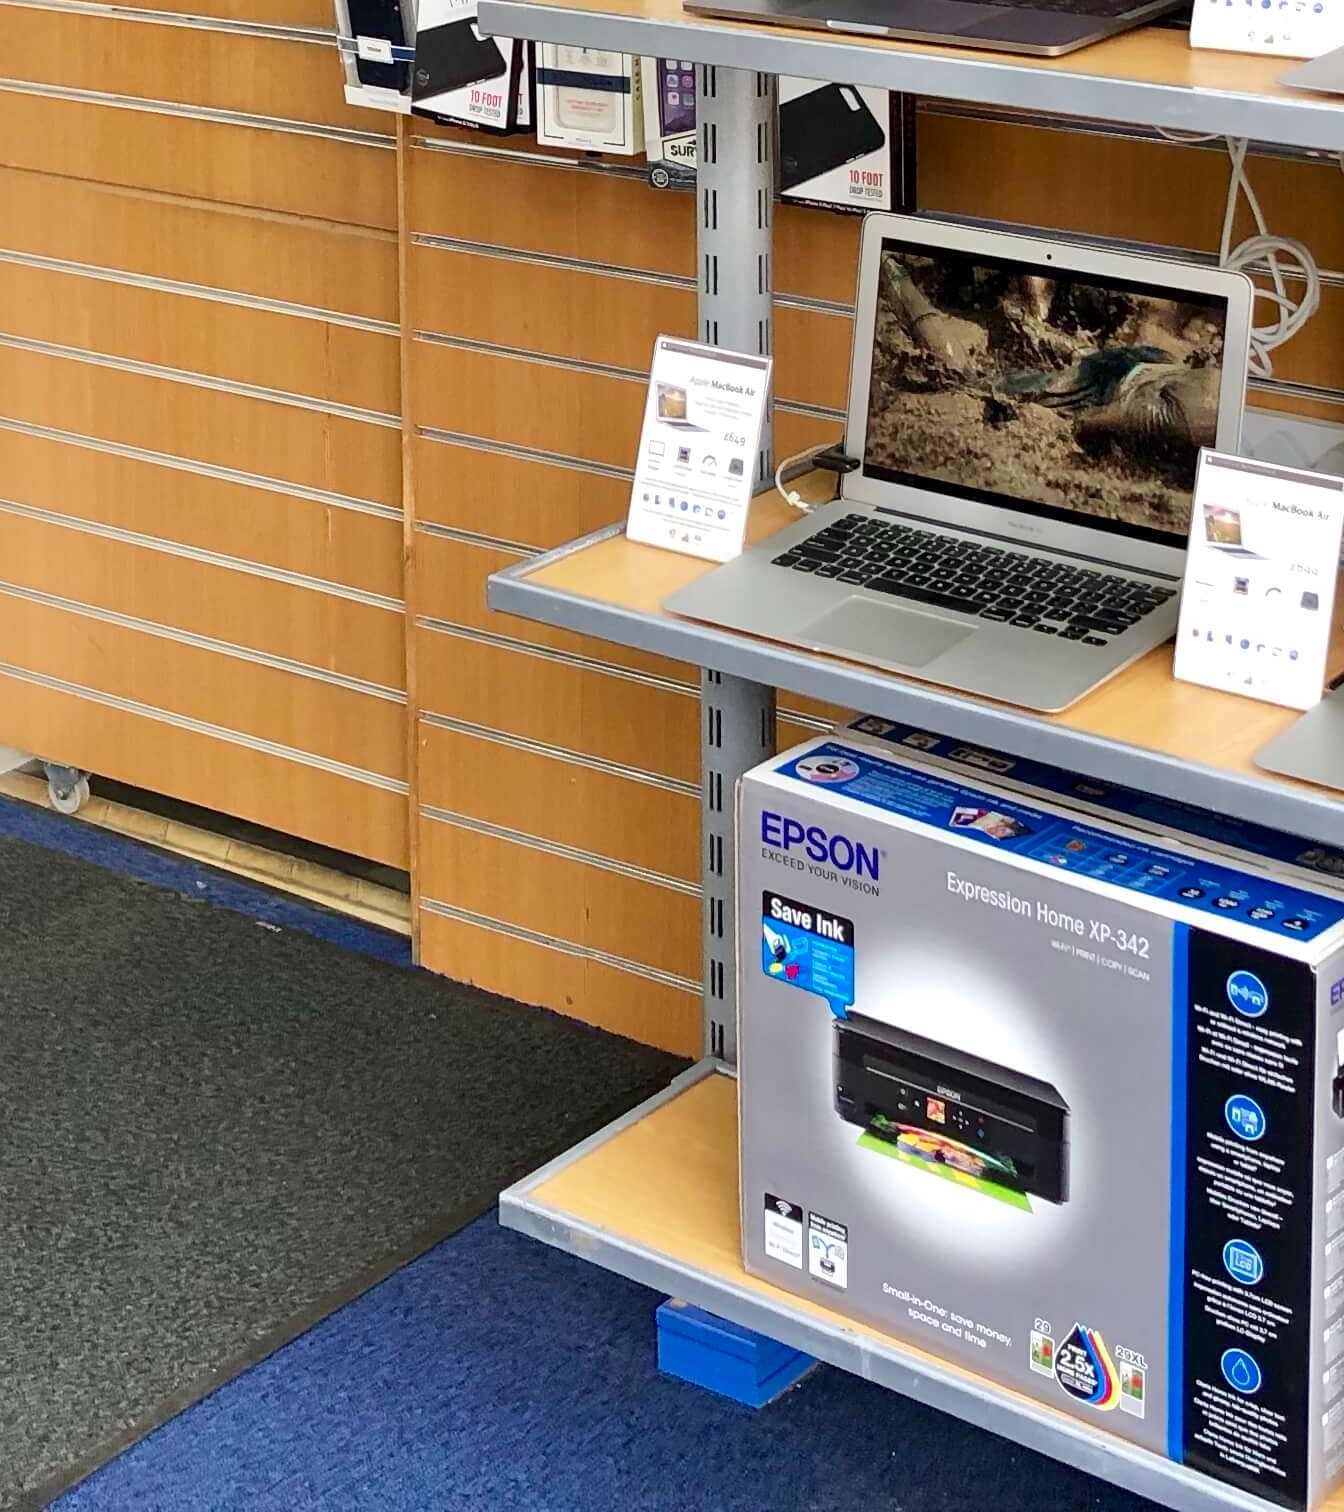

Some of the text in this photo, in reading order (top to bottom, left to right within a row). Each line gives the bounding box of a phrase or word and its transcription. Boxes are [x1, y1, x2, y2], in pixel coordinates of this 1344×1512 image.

[471, 90, 503, 107] 10 FOOT
[670, 145, 696, 157] SUR
[849, 169, 884, 187] 10 FOOT
[711, 379, 744, 395] MacBook
[745, 384, 757, 397] Air
[1272, 501, 1315, 518] MacBook
[761, 810, 880, 881] EPSON
[761, 847, 880, 897] EXCEED YOUR VISION
[770, 897, 845, 942] Save Ink
[946, 871, 1151, 959] Expression Home XP-342
[907, 1307, 987, 1349] space and time
[949, 1313, 975, 1329] save
[1035, 1318, 1051, 1334] 29
